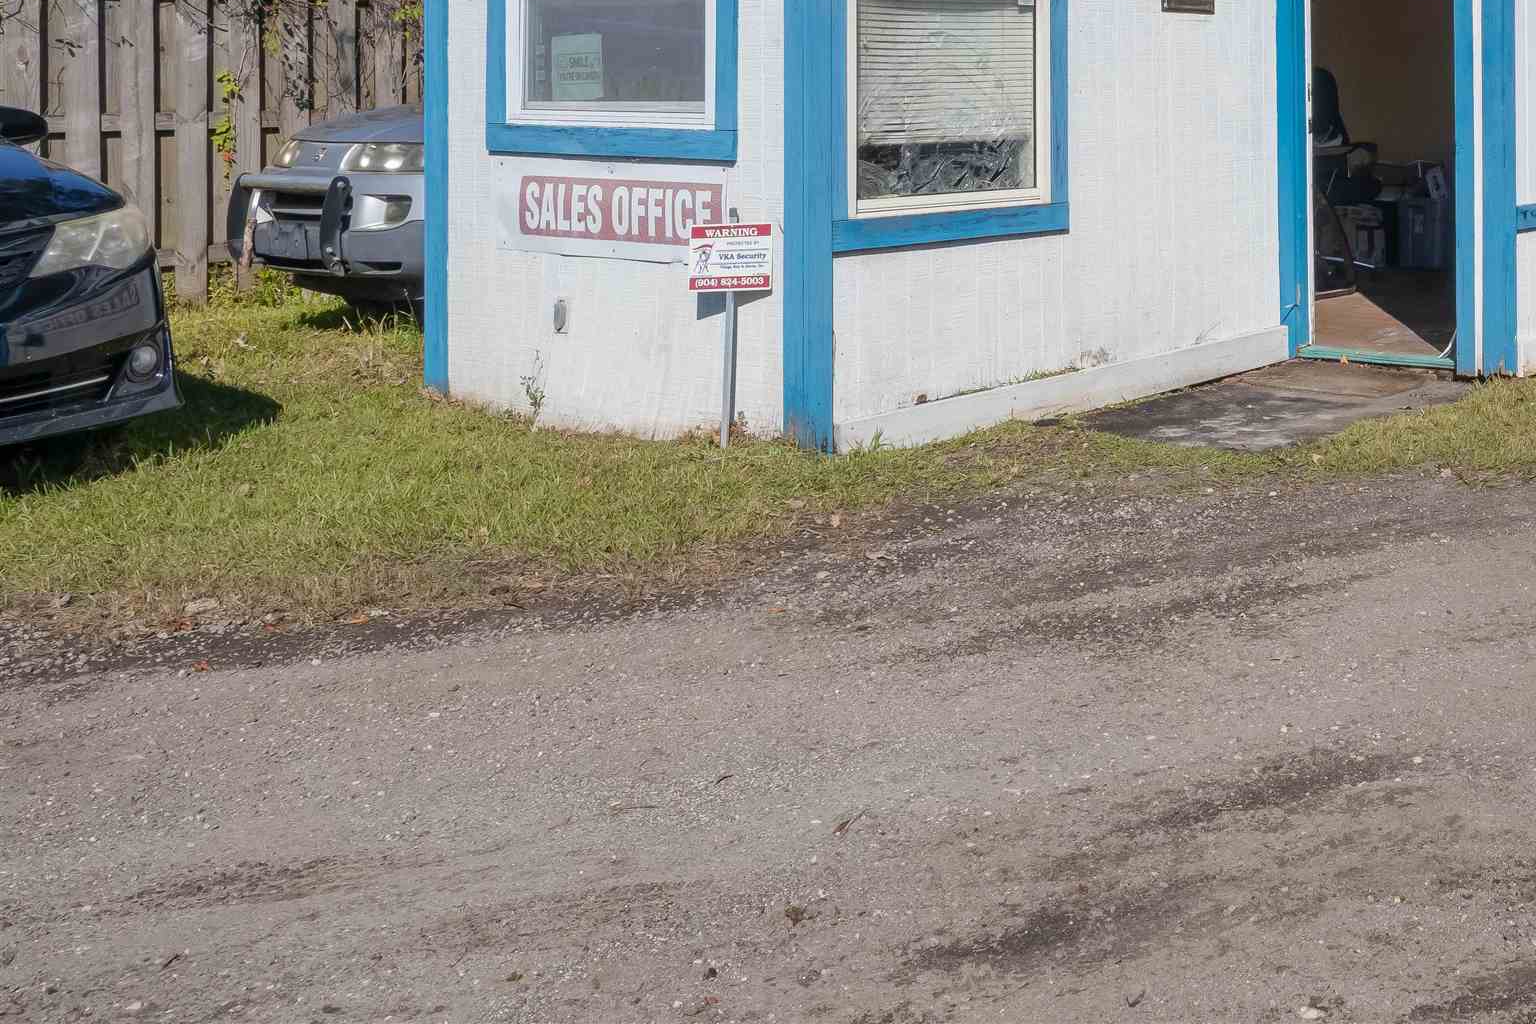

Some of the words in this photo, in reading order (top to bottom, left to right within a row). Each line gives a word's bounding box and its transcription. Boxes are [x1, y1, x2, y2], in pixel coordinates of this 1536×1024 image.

[525, 181, 603, 235] SALES
[612, 185, 713, 241] OFFICE
[704, 227, 758, 238] WARNING
[719, 253, 735, 261] VKA
[736, 252, 767, 261] Security
[695, 278, 718, 288] (904)
[720, 276, 764, 287] 824-5003
